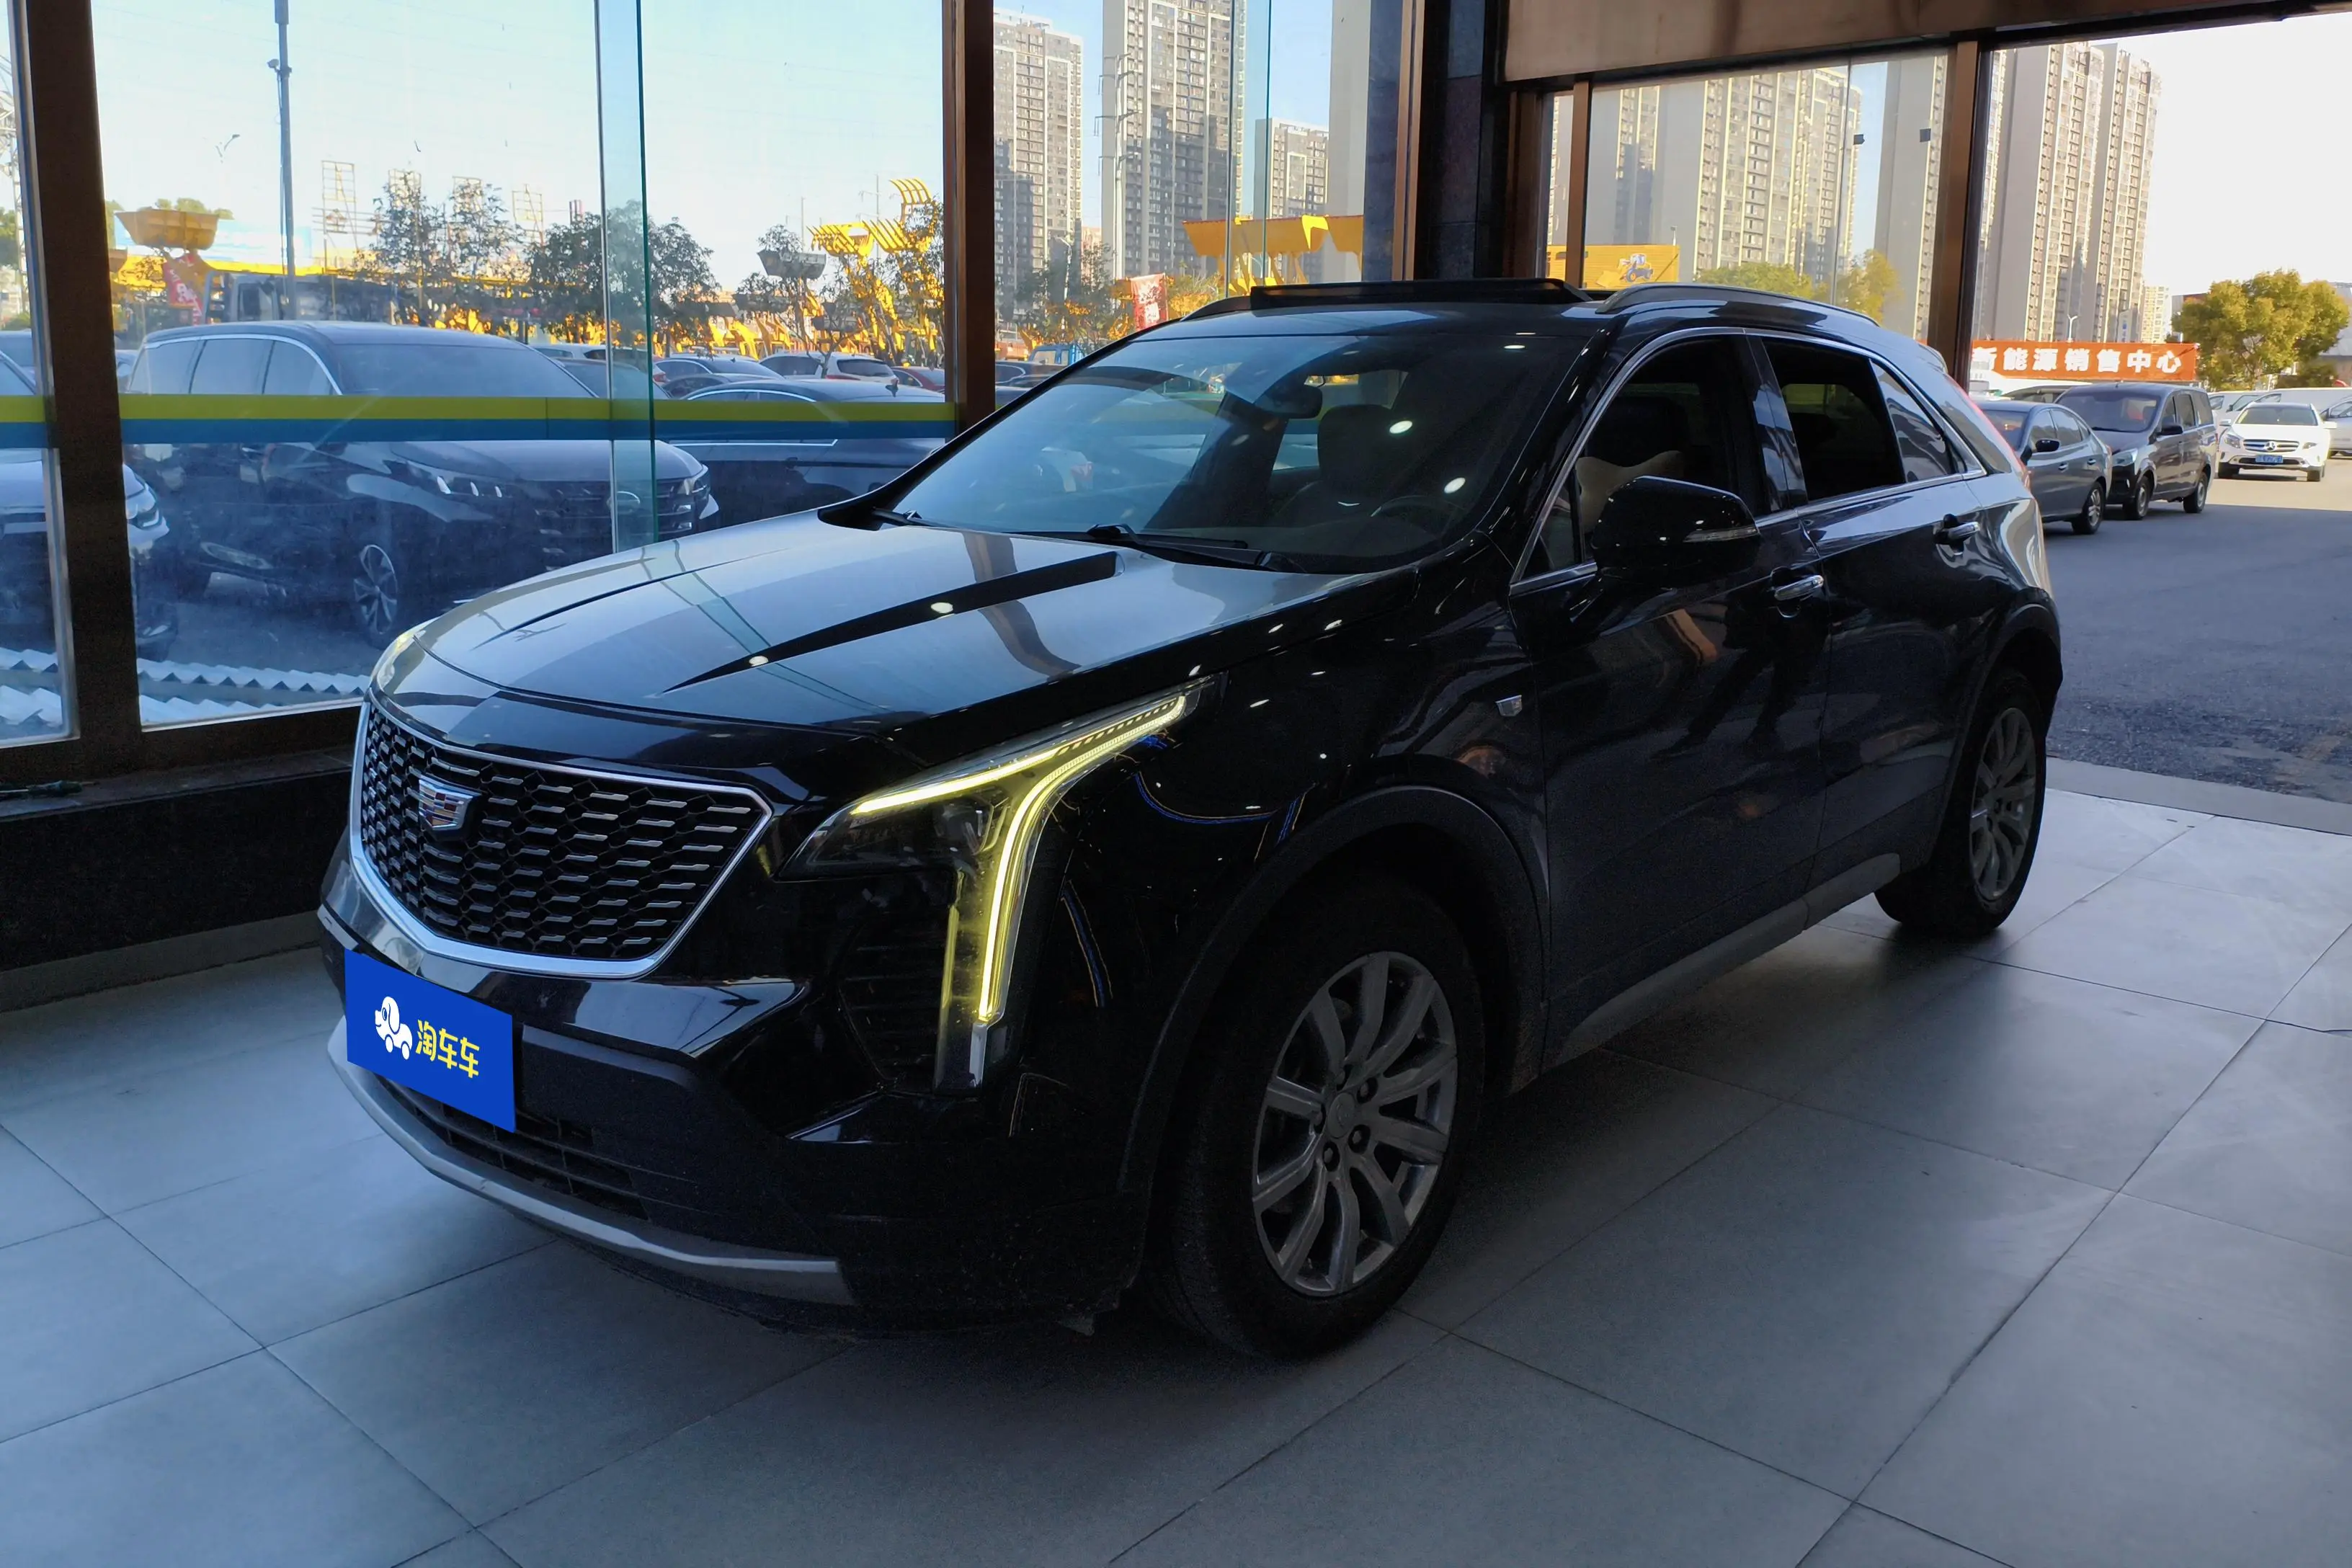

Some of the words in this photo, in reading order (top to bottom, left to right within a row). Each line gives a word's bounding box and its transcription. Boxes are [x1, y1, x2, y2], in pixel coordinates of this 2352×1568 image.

[1972, 347, 2182, 373] 新能源销售中心
